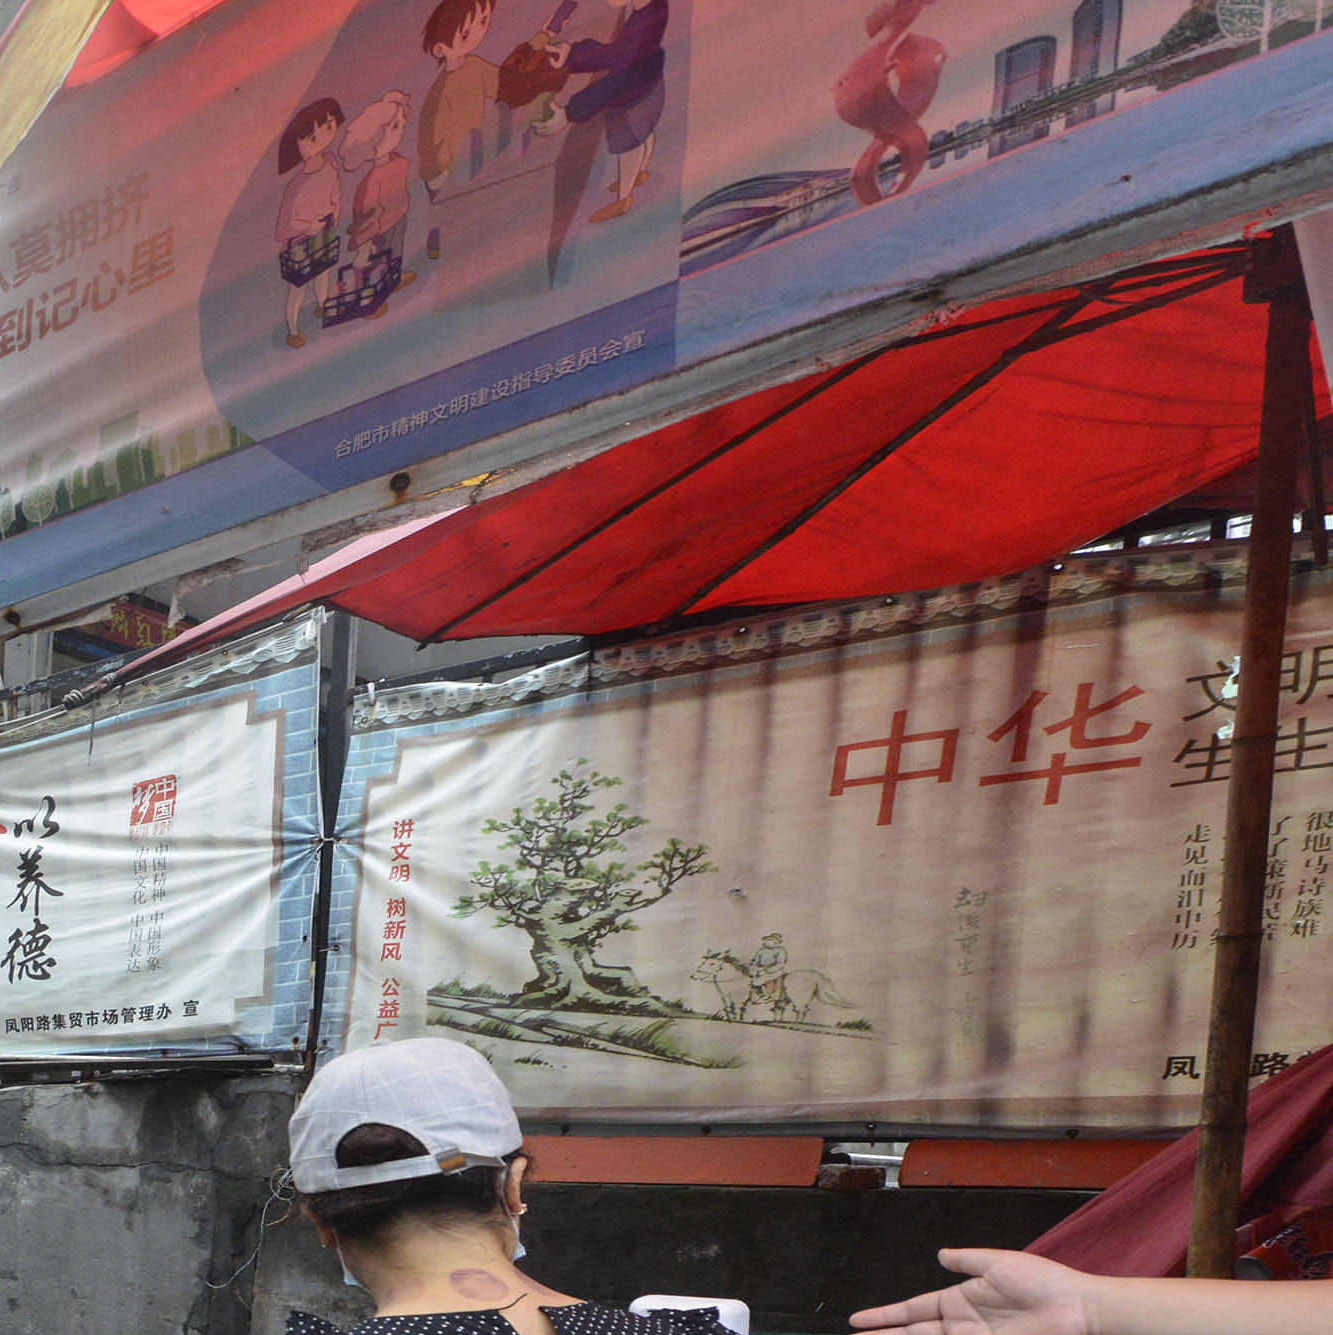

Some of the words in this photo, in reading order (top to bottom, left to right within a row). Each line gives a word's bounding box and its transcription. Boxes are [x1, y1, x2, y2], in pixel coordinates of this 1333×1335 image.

[335, 328, 646, 458] 合肥市精神文明建设指导委员会宣
[829, 681, 1152, 826] 中华
[132, 845, 150, 905] 中国文化
[151, 842, 169, 903] 中国精神
[389, 818, 414, 882] 讲文明
[126, 914, 145, 974] 中国表达
[146, 910, 165, 971] 中国形象
[380, 897, 406, 962] 树新风
[4, 1003, 172, 1034] 凤阳路集贸市场管理办
[182, 1000, 200, 1018] 宣
